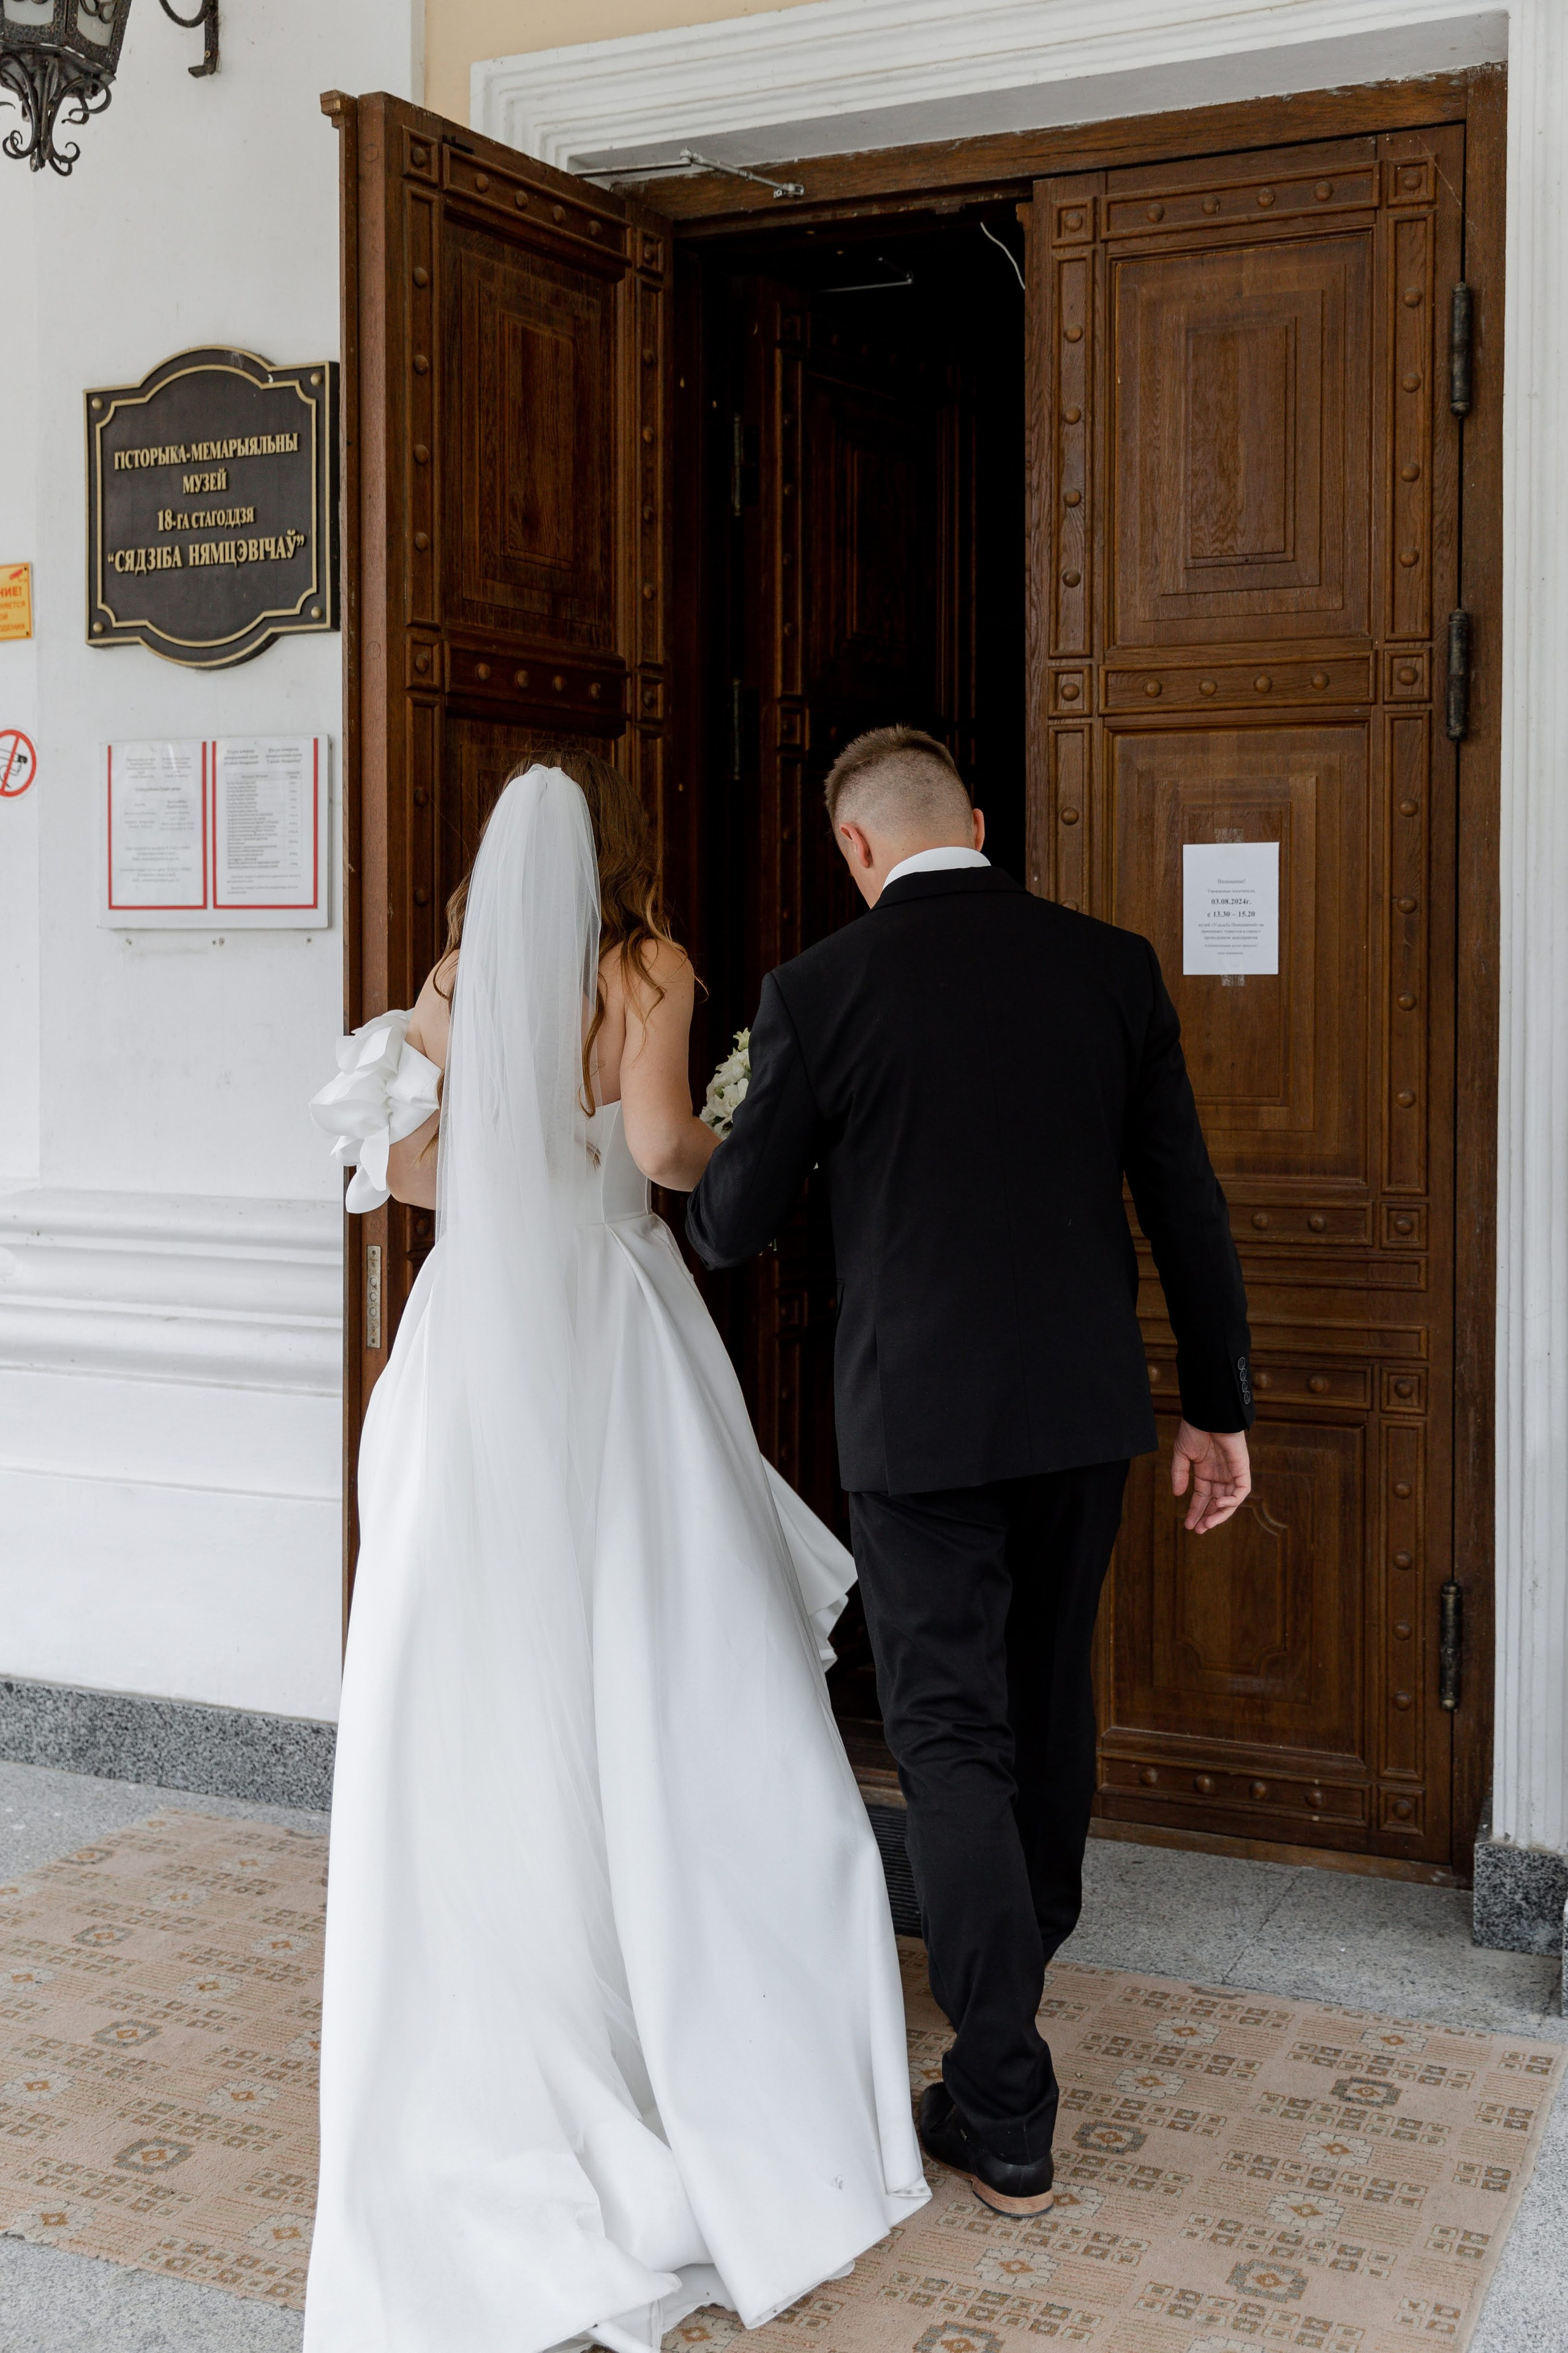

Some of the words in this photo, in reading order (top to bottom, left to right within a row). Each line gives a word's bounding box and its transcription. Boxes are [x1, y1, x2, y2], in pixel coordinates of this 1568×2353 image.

[113, 432, 300, 470] ГІСТОРЫКА-МЕМАРЫЯЛЬНЫ
[183, 467, 228, 494] МУЗЕЙ
[157, 508, 190, 532] 18-ГА
[191, 506, 255, 529] СТАГОДДЗЯ
